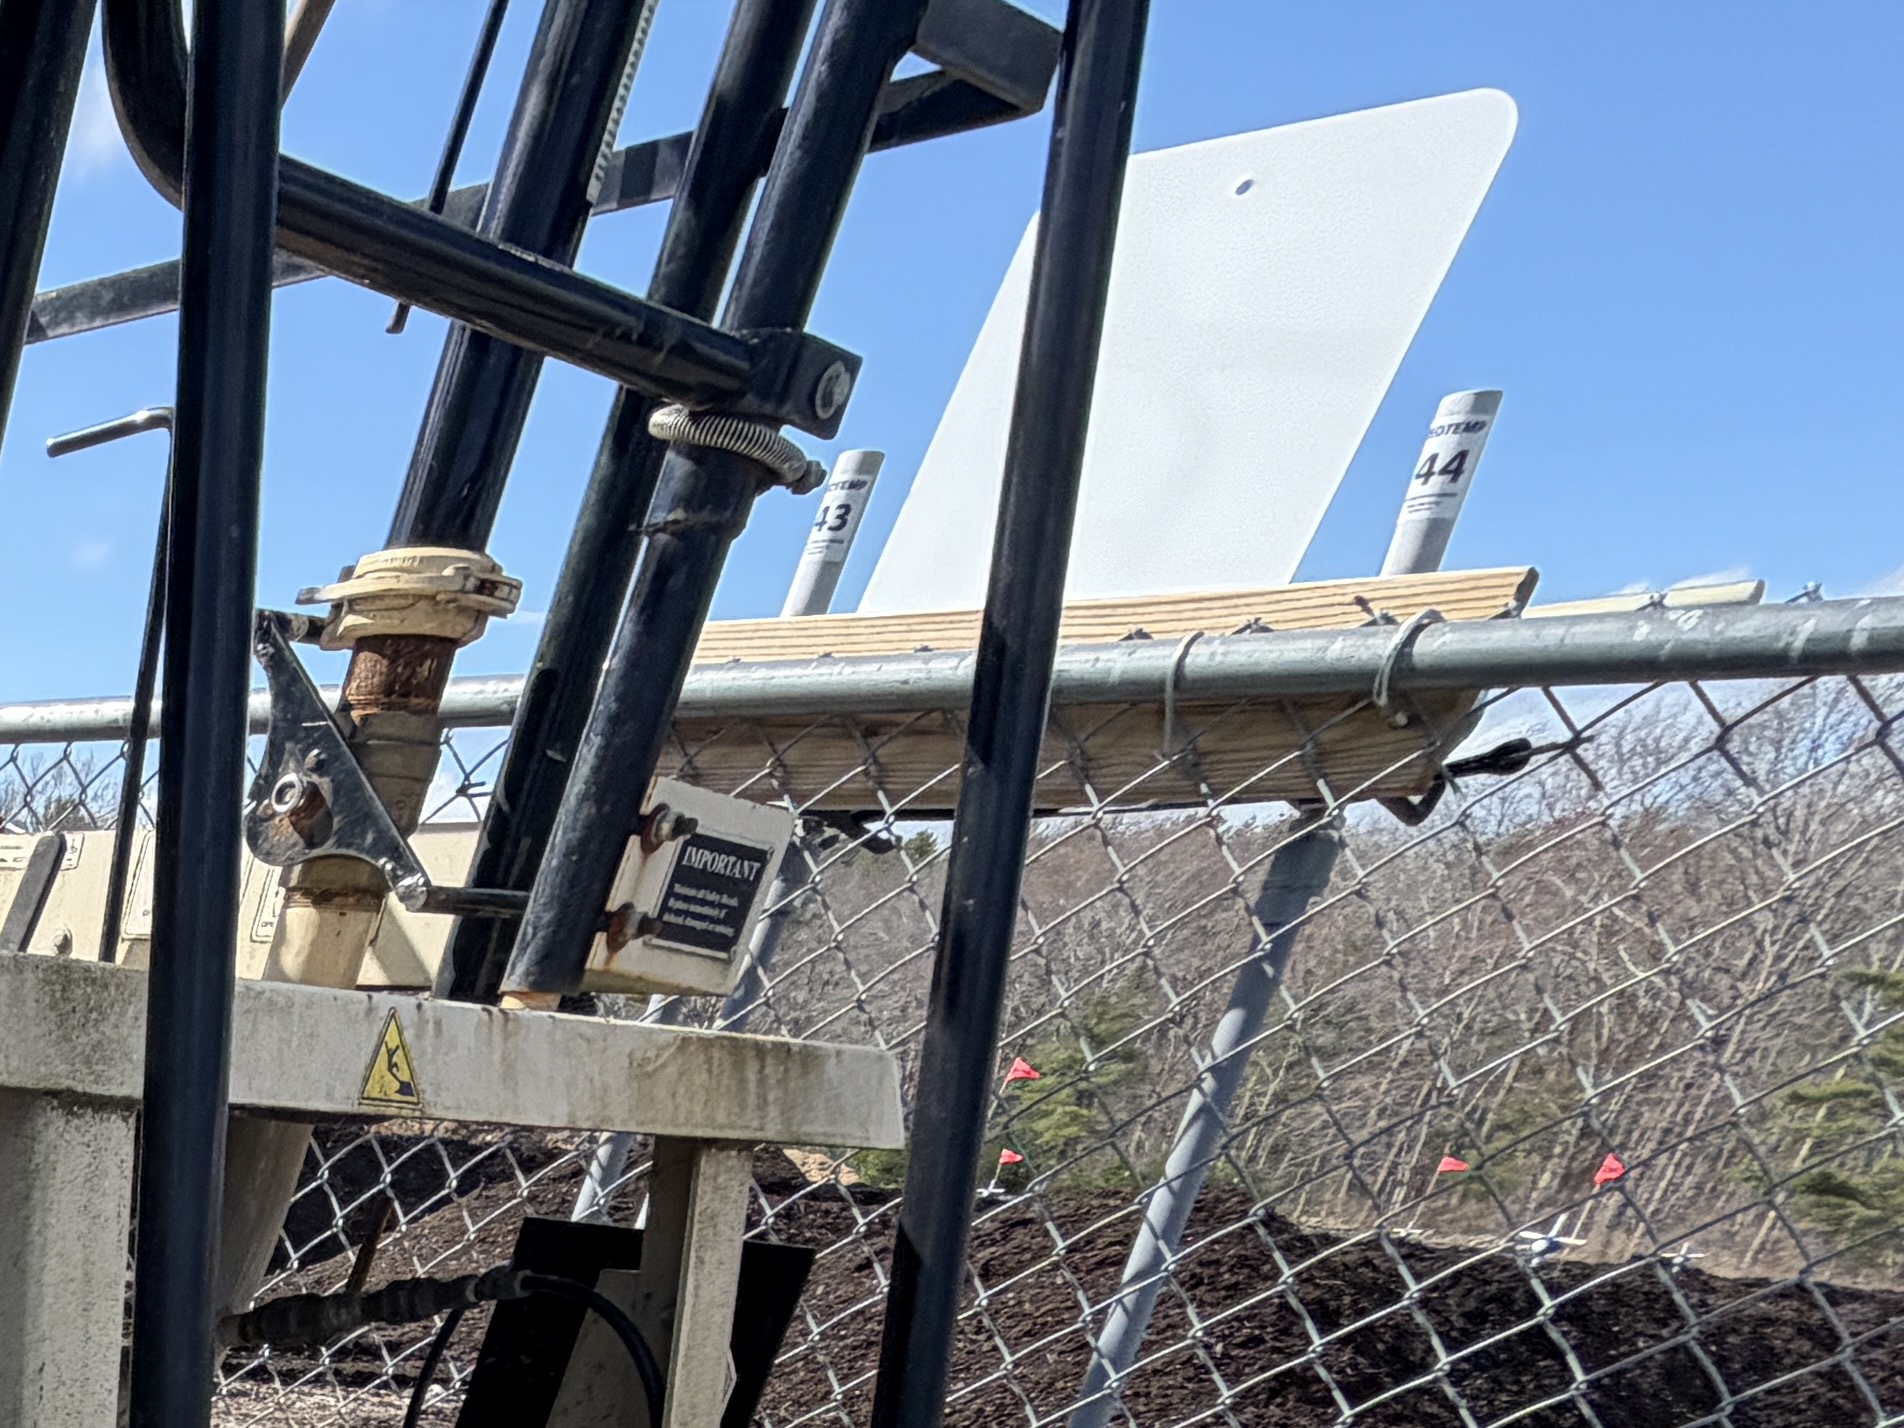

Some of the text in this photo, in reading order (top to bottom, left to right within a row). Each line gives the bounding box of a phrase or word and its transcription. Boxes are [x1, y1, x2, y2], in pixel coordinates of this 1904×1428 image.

[1415, 449, 1470, 486] 44
[814, 503, 852, 532] 43
[681, 846, 762, 882] IMPORTANT
